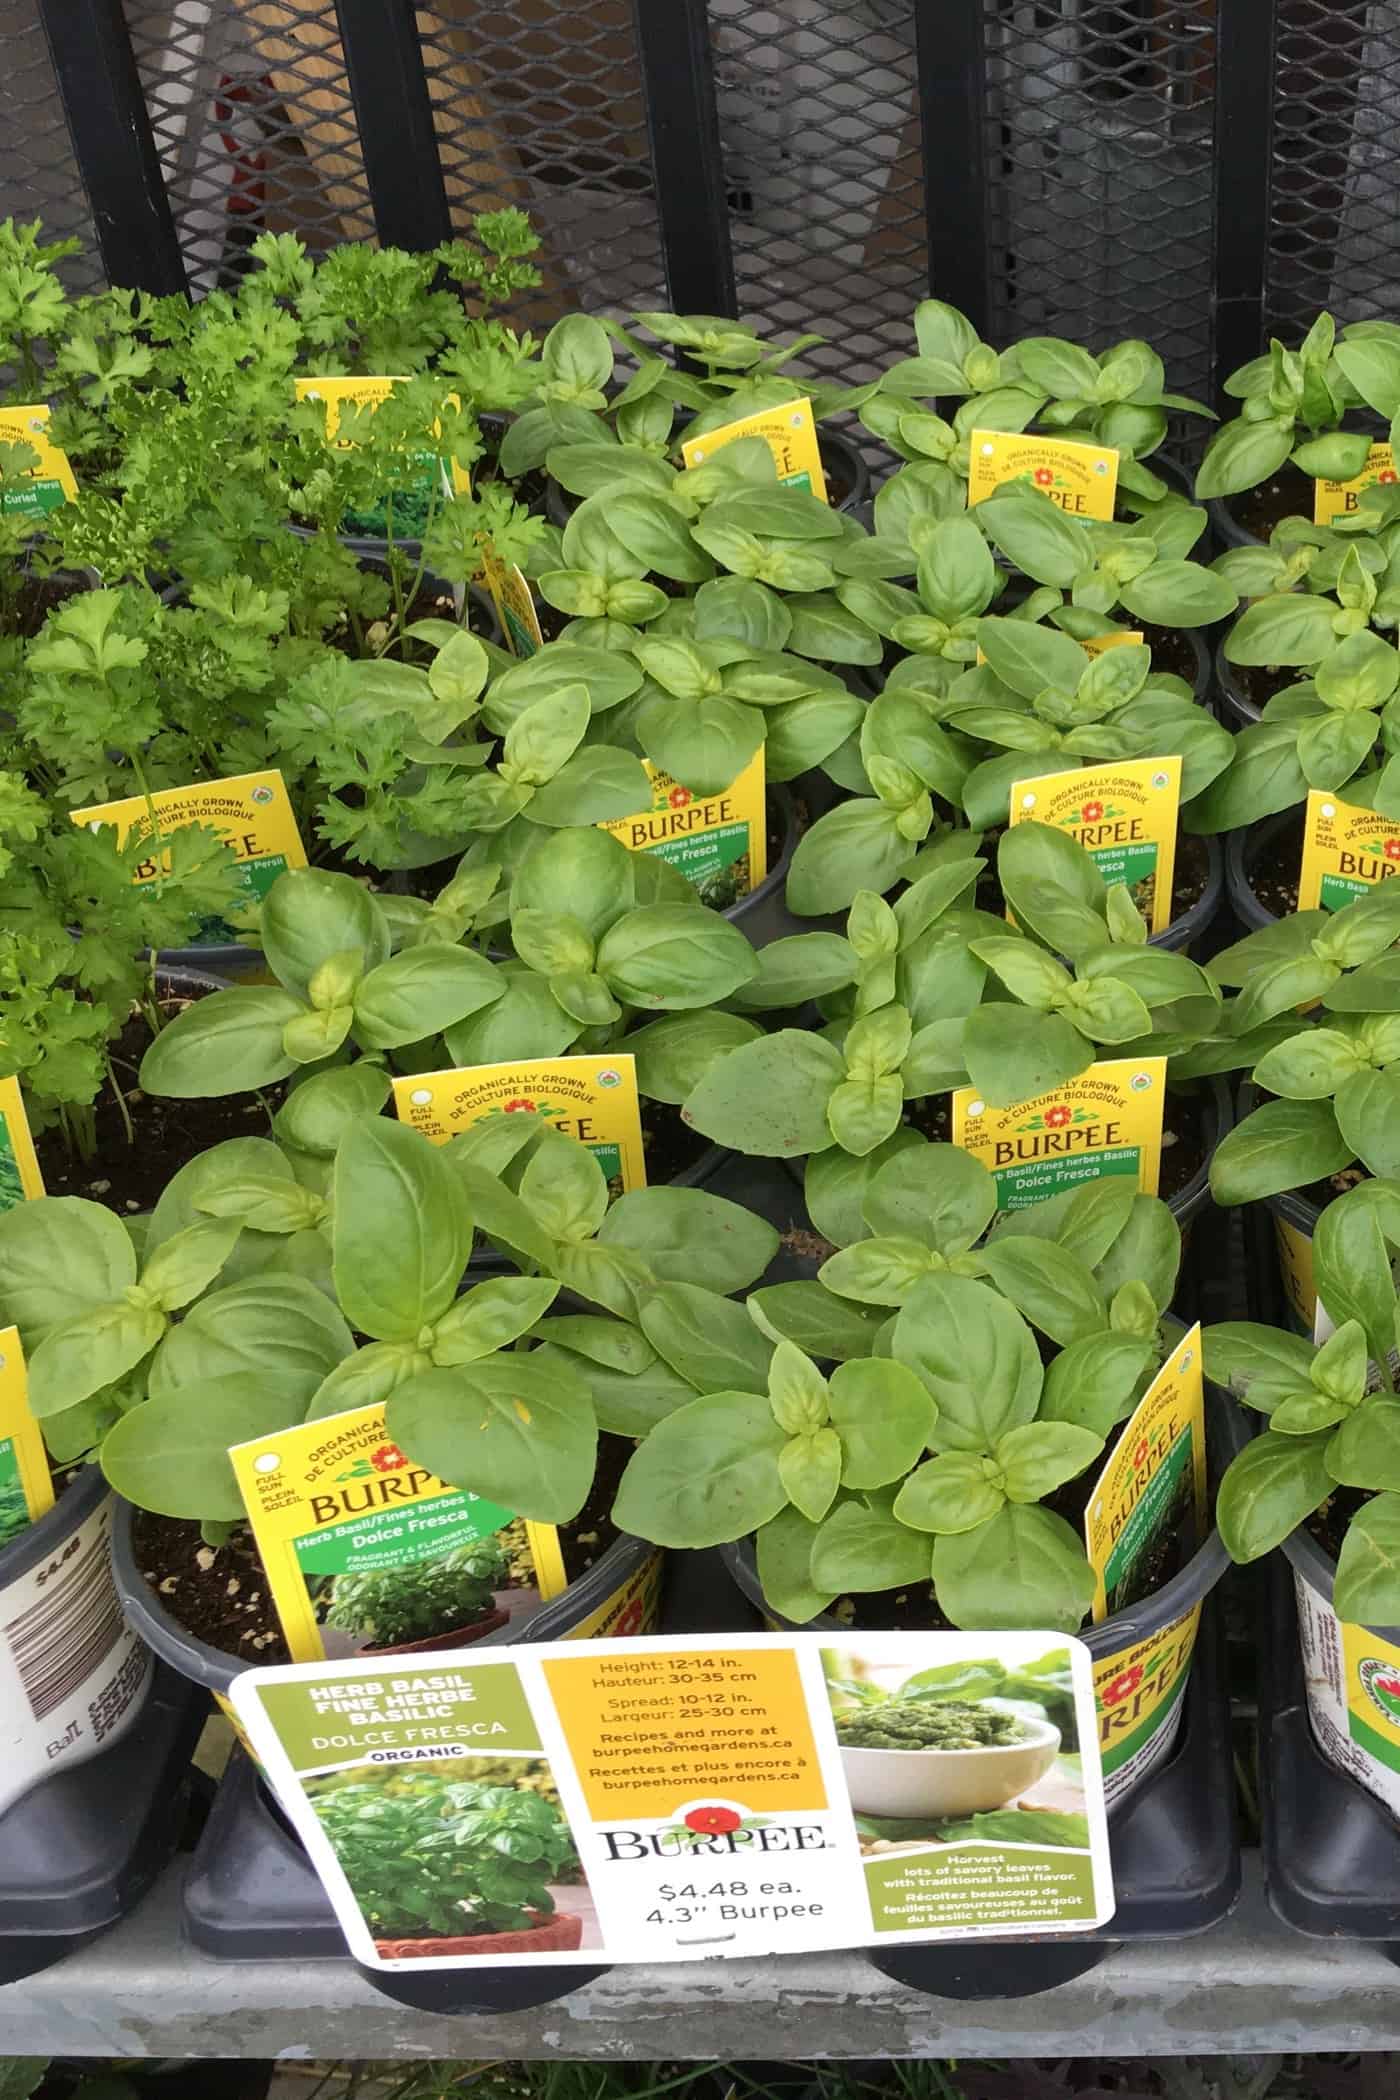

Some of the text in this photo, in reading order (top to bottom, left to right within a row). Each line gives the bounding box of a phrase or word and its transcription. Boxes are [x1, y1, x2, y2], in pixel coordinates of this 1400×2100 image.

[202, 798, 244, 808] GROWN
[1049, 778, 1110, 807] ORGANICALLY
[189, 807, 256, 821] BIOLOGIQUE
[631, 799, 735, 847] BURPEE
[1072, 818, 1145, 847] RPEE
[682, 845, 719, 861] Fresca
[454, 1074, 587, 1104] ORGANICALLY GROWN
[1081, 1080, 1120, 1093] GROWN
[449, 1085, 598, 1120] DE CULTURE BIOLOGIQUE
[997, 1116, 1012, 1130] DE
[1012, 1093, 1063, 1119] CULTURE
[1064, 1091, 1128, 1109] BIOLOGIQUE
[994, 1122, 1123, 1166] BURPEE
[1006, 1160, 1065, 1179] Basil/Fines
[1066, 1155, 1101, 1167] herbes
[1103, 1150, 1137, 1161] Basilic
[1015, 1174, 1052, 1190] Dolce
[1056, 1166, 1101, 1183] Fresca
[308, 1418, 387, 1462] ORGANICA
[304, 1431, 390, 1482] DE CULTURE
[256, 1472, 287, 1486] FULL
[258, 1482, 282, 1494] SUN
[1109, 1412, 1183, 1545] BURPEE
[261, 1488, 296, 1504] PLEIN
[264, 1495, 305, 1512] SOLEIL
[310, 1468, 449, 1524] BURP
[296, 1531, 333, 1549] Herb
[335, 1508, 416, 1538] Basil/Fines
[418, 1493, 466, 1514] herbes
[351, 1509, 469, 1549] Dolce Fresca
[345, 1548, 404, 1564] FRAGRANT
[347, 1531, 481, 1571] ODORANT ET SAVOUREUX
[600, 1656, 742, 1674] Height: 12-14 in.
[308, 1674, 473, 1701] HERB BASIL
[592, 1672, 757, 1689] Hauteur: 30-35 cm
[1101, 1629, 1195, 1742] RPEE
[314, 1689, 477, 1714] FINE HERBE
[607, 1692, 752, 1710] Spread: 10-12 in.
[349, 1705, 455, 1726] BASILIC
[600, 1706, 767, 1725] Largeur: 25-30 cm
[311, 1721, 508, 1750] DOLCE FRESCA
[600, 1725, 779, 1745] Recipes and more at
[371, 1746, 464, 1762] ORGANIC
[592, 1738, 793, 1759] burpeehomegardens.ca
[589, 1756, 807, 1778] Recettes et plus encore à
[602, 1770, 801, 1791] burpeehomegardens.ca
[596, 1824, 827, 1861] BURPEE
[904, 1863, 1051, 1877] lots of savory leaves
[948, 1855, 1006, 1865] Harvest
[883, 1872, 1077, 1888] with traditional basil flavor.
[657, 1881, 802, 1902] $4.48 ea.
[905, 1887, 1059, 1902] Récoltez beaucoup de
[719, 1901, 824, 1921] Burpee
[883, 1896, 1084, 1915] feuilles savoureuses au goût
[907, 1907, 1063, 1924] du basilic traditionnel.
